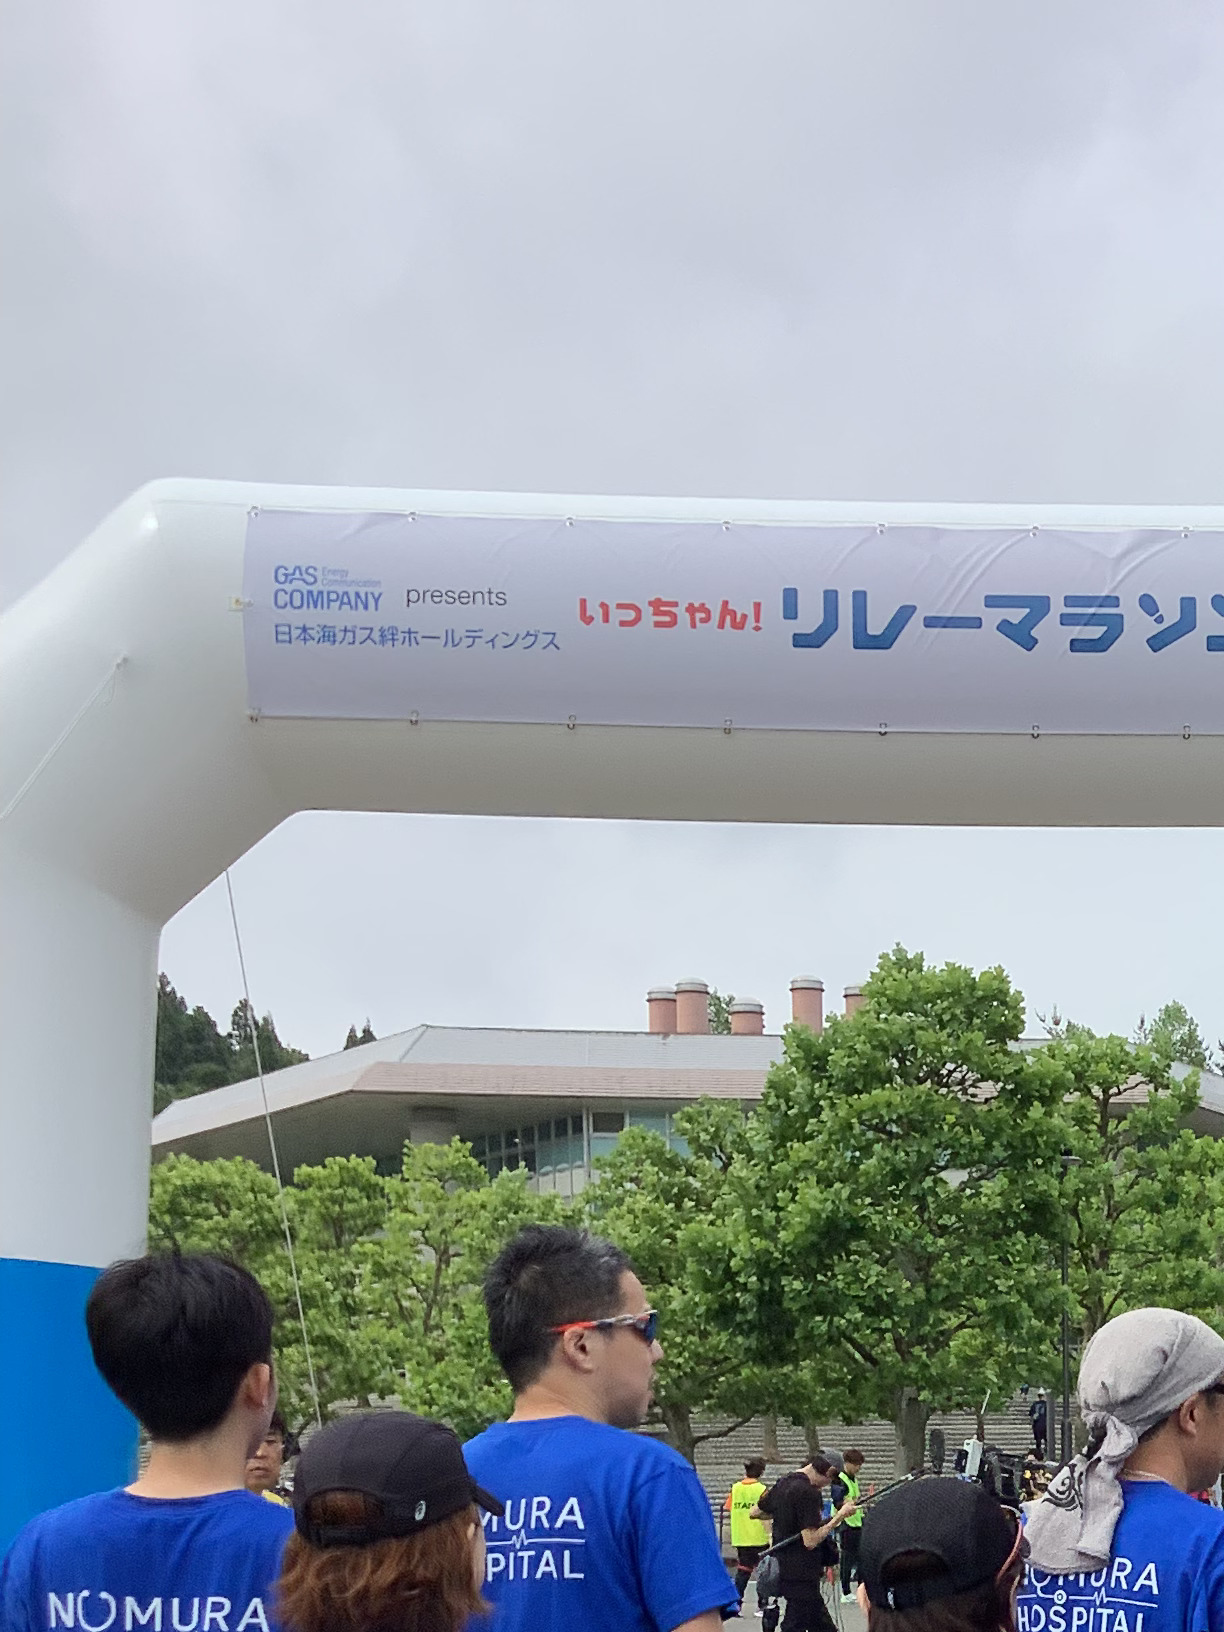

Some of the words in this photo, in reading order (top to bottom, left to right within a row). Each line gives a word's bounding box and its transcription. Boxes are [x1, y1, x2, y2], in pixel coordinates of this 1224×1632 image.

[273, 565, 318, 586] GAS
[273, 588, 383, 612] COMPANY
[406, 586, 508, 608] presents
[274, 623, 560, 651] 日本海ガス絆ホールディングス
[481, 1496, 585, 1532] URA
[486, 1549, 585, 1582] PITAL
[48, 1589, 270, 1632] NOMURA
